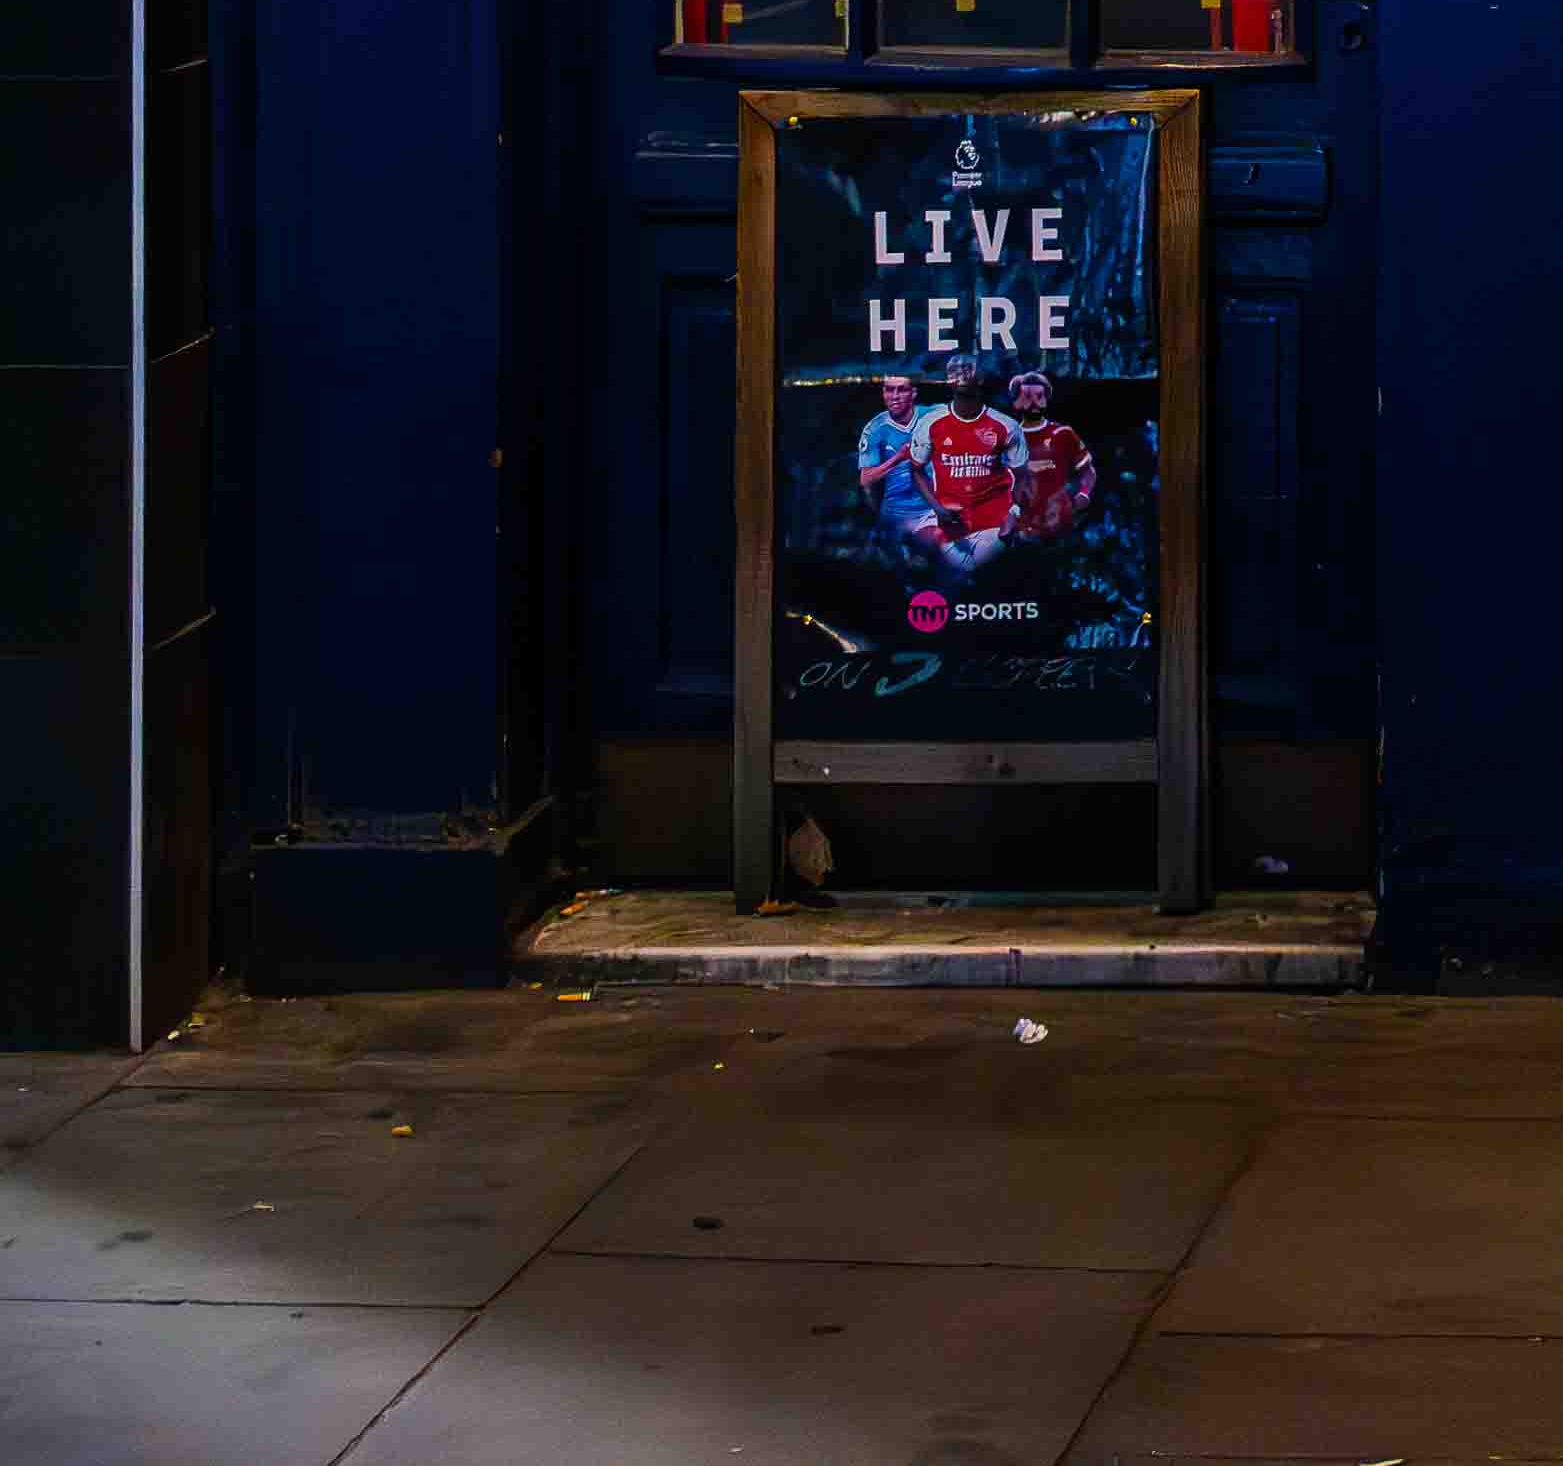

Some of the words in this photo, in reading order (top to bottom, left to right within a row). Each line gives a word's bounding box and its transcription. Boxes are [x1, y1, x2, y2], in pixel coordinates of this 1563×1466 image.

[874, 208, 1063, 264] LIVE
[868, 295, 1070, 352] HERE
[909, 604, 949, 621] TNT
[954, 602, 1039, 621] SPORTS
